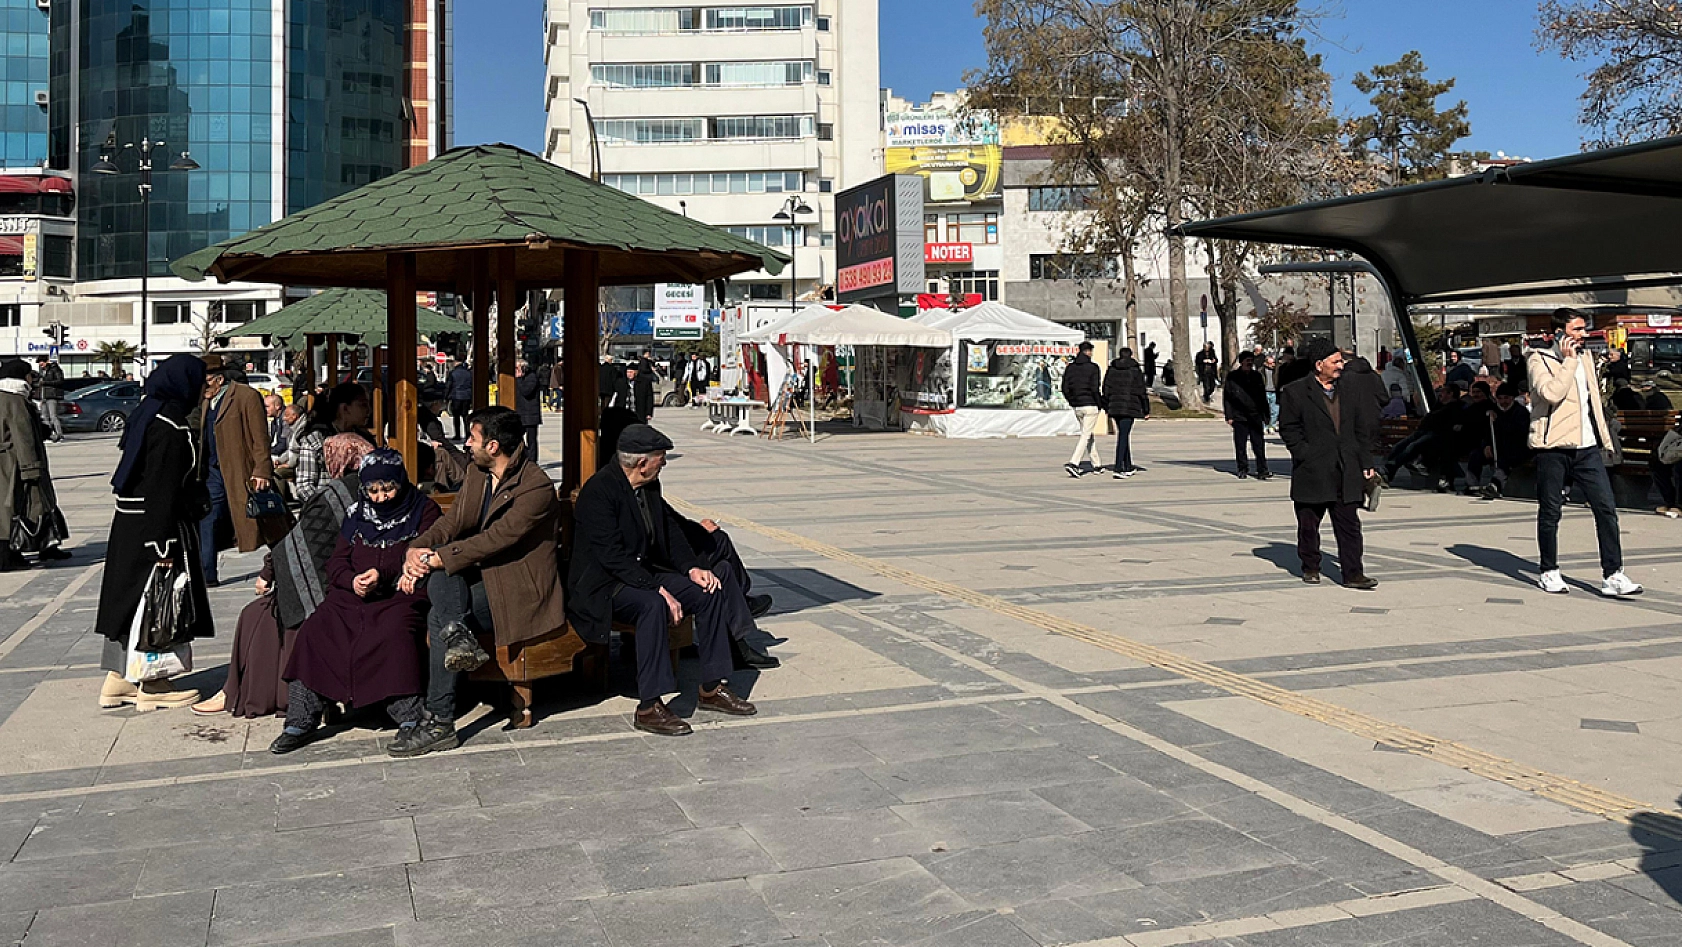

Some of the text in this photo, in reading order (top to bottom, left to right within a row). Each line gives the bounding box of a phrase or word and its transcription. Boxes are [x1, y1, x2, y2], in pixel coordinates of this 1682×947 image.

[903, 123, 946, 137] misaş
[931, 245, 971, 259] NOTER
[665, 289, 694, 298] GECESİ
[996, 343, 1031, 355] SESSİZ
